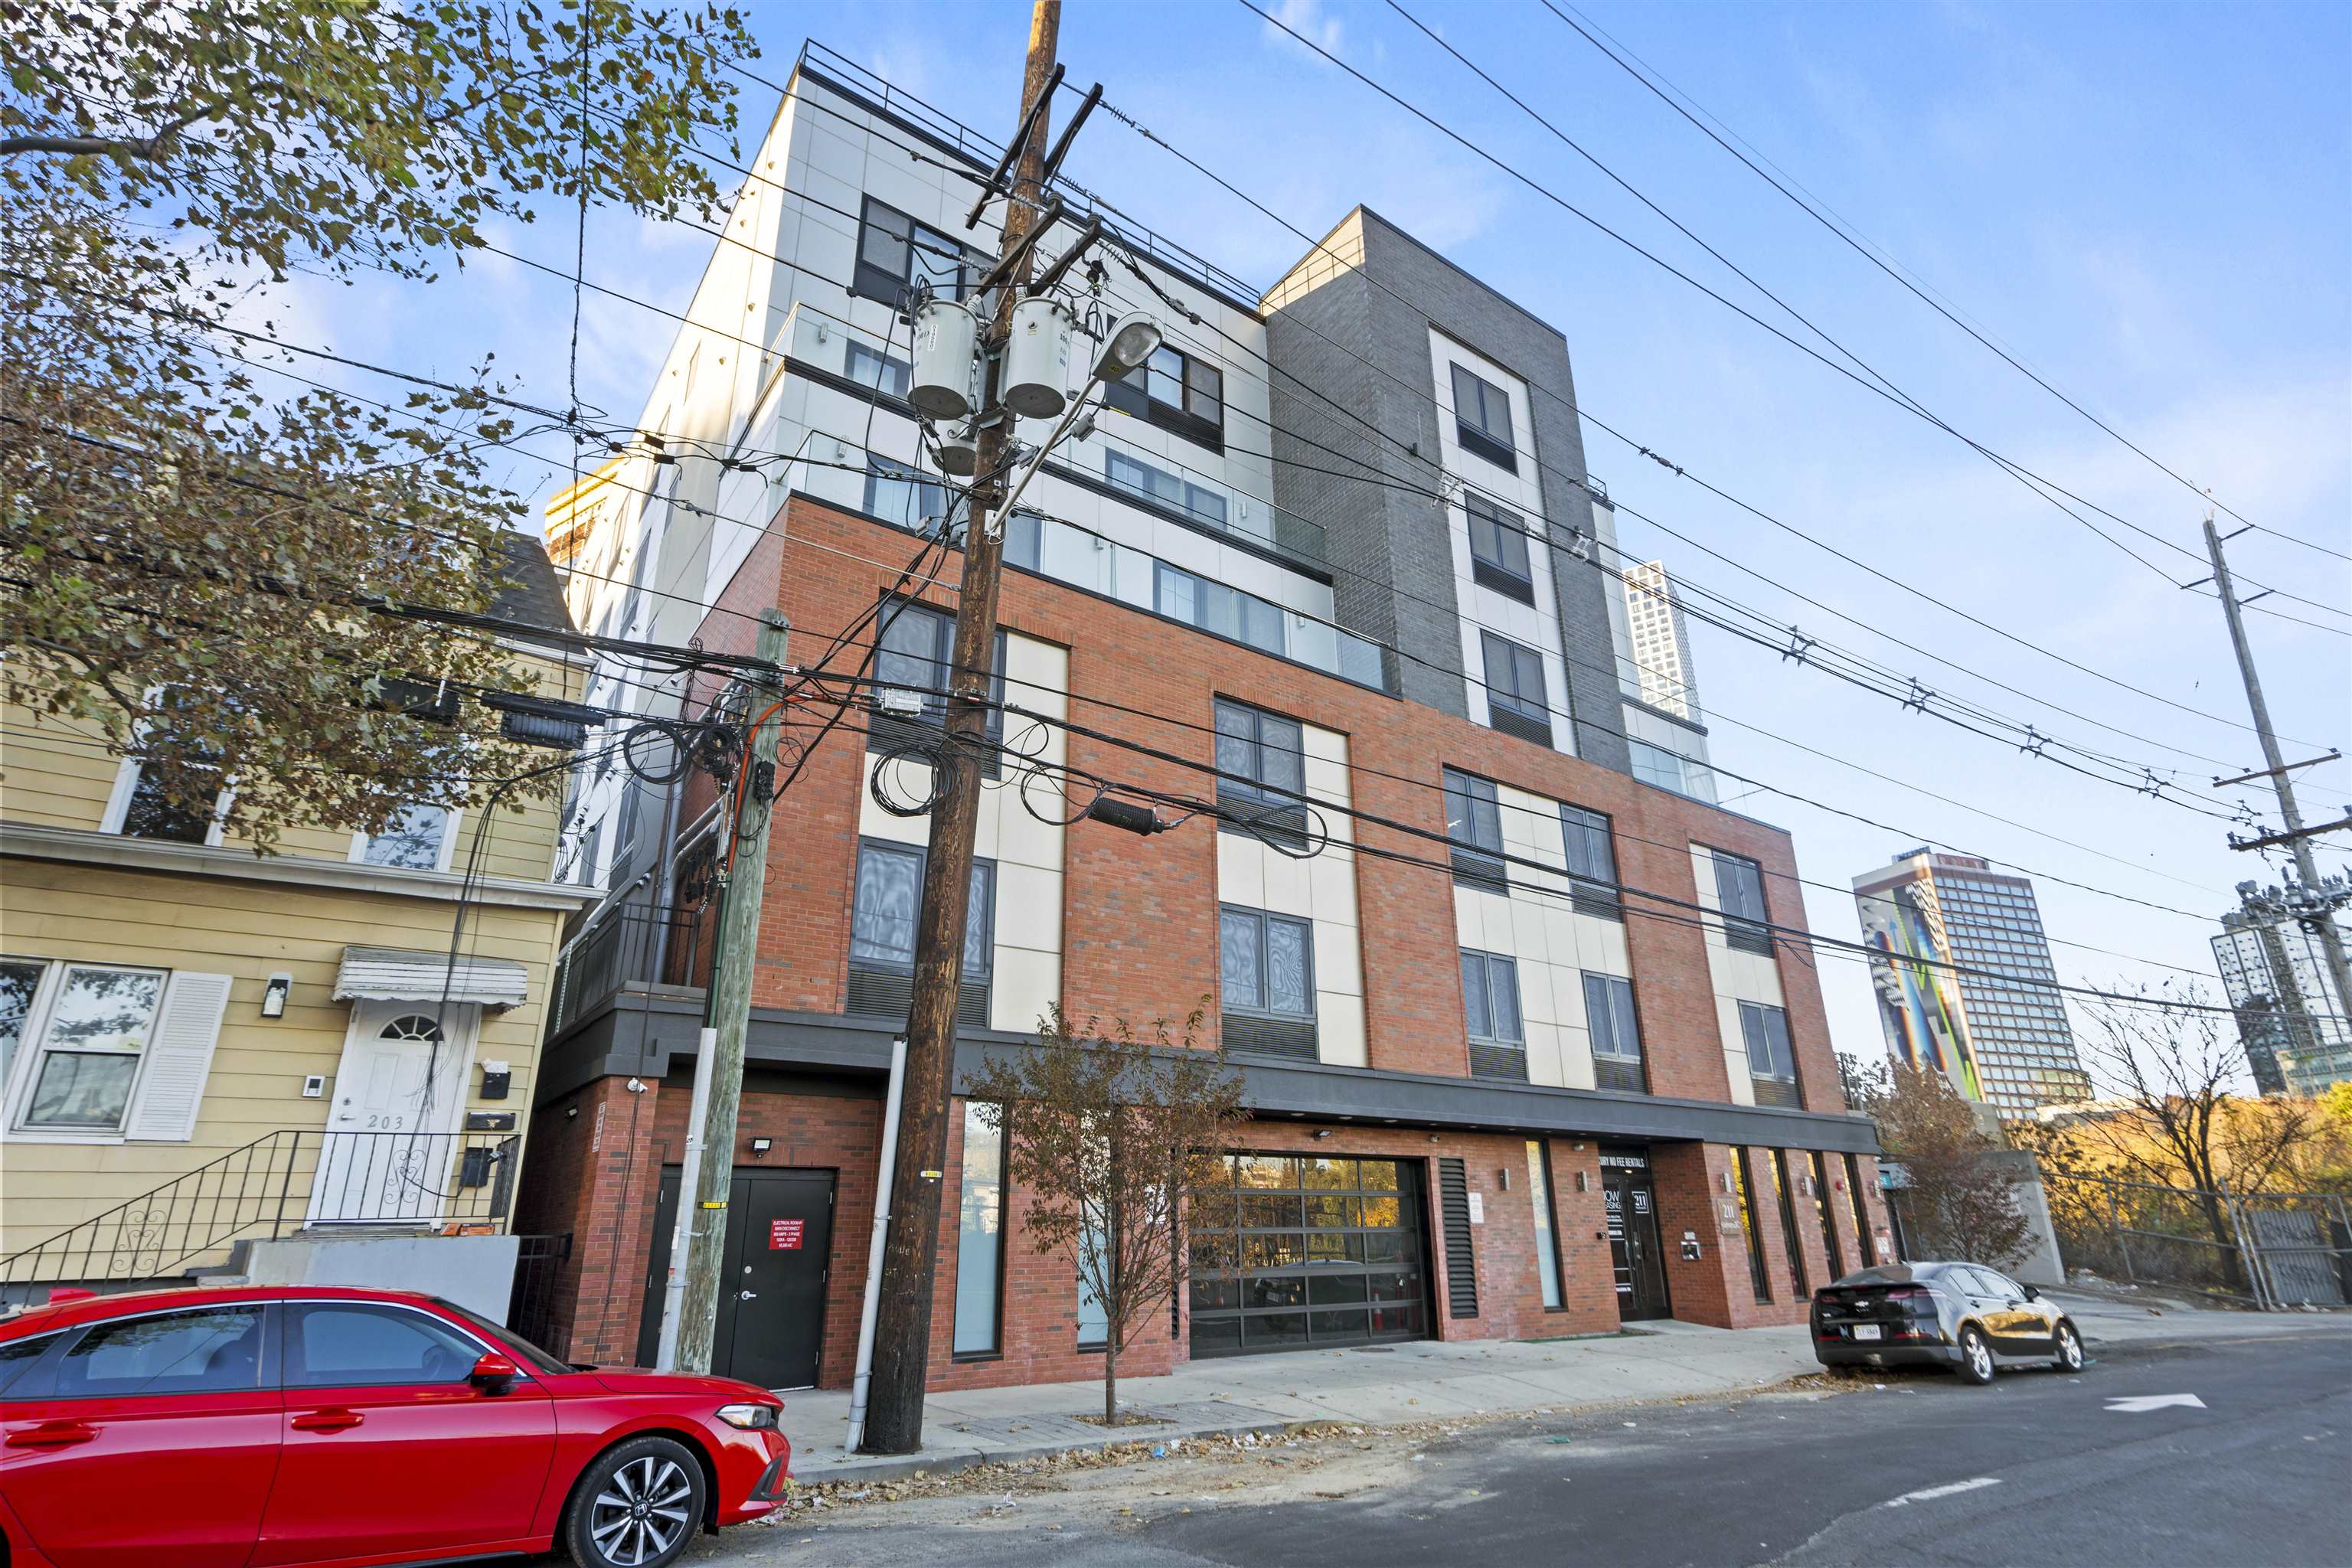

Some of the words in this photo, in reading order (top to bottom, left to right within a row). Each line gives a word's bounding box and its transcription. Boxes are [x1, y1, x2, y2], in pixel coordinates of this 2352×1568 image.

[368, 1115, 403, 1129] 203
[1609, 1156, 1617, 1166] NO
[1616, 1157, 1625, 1167] FEE
[1625, 1157, 1645, 1168] RENTALS
[1634, 1194, 1647, 1207] 211
[1723, 1204, 1735, 1218] 211
